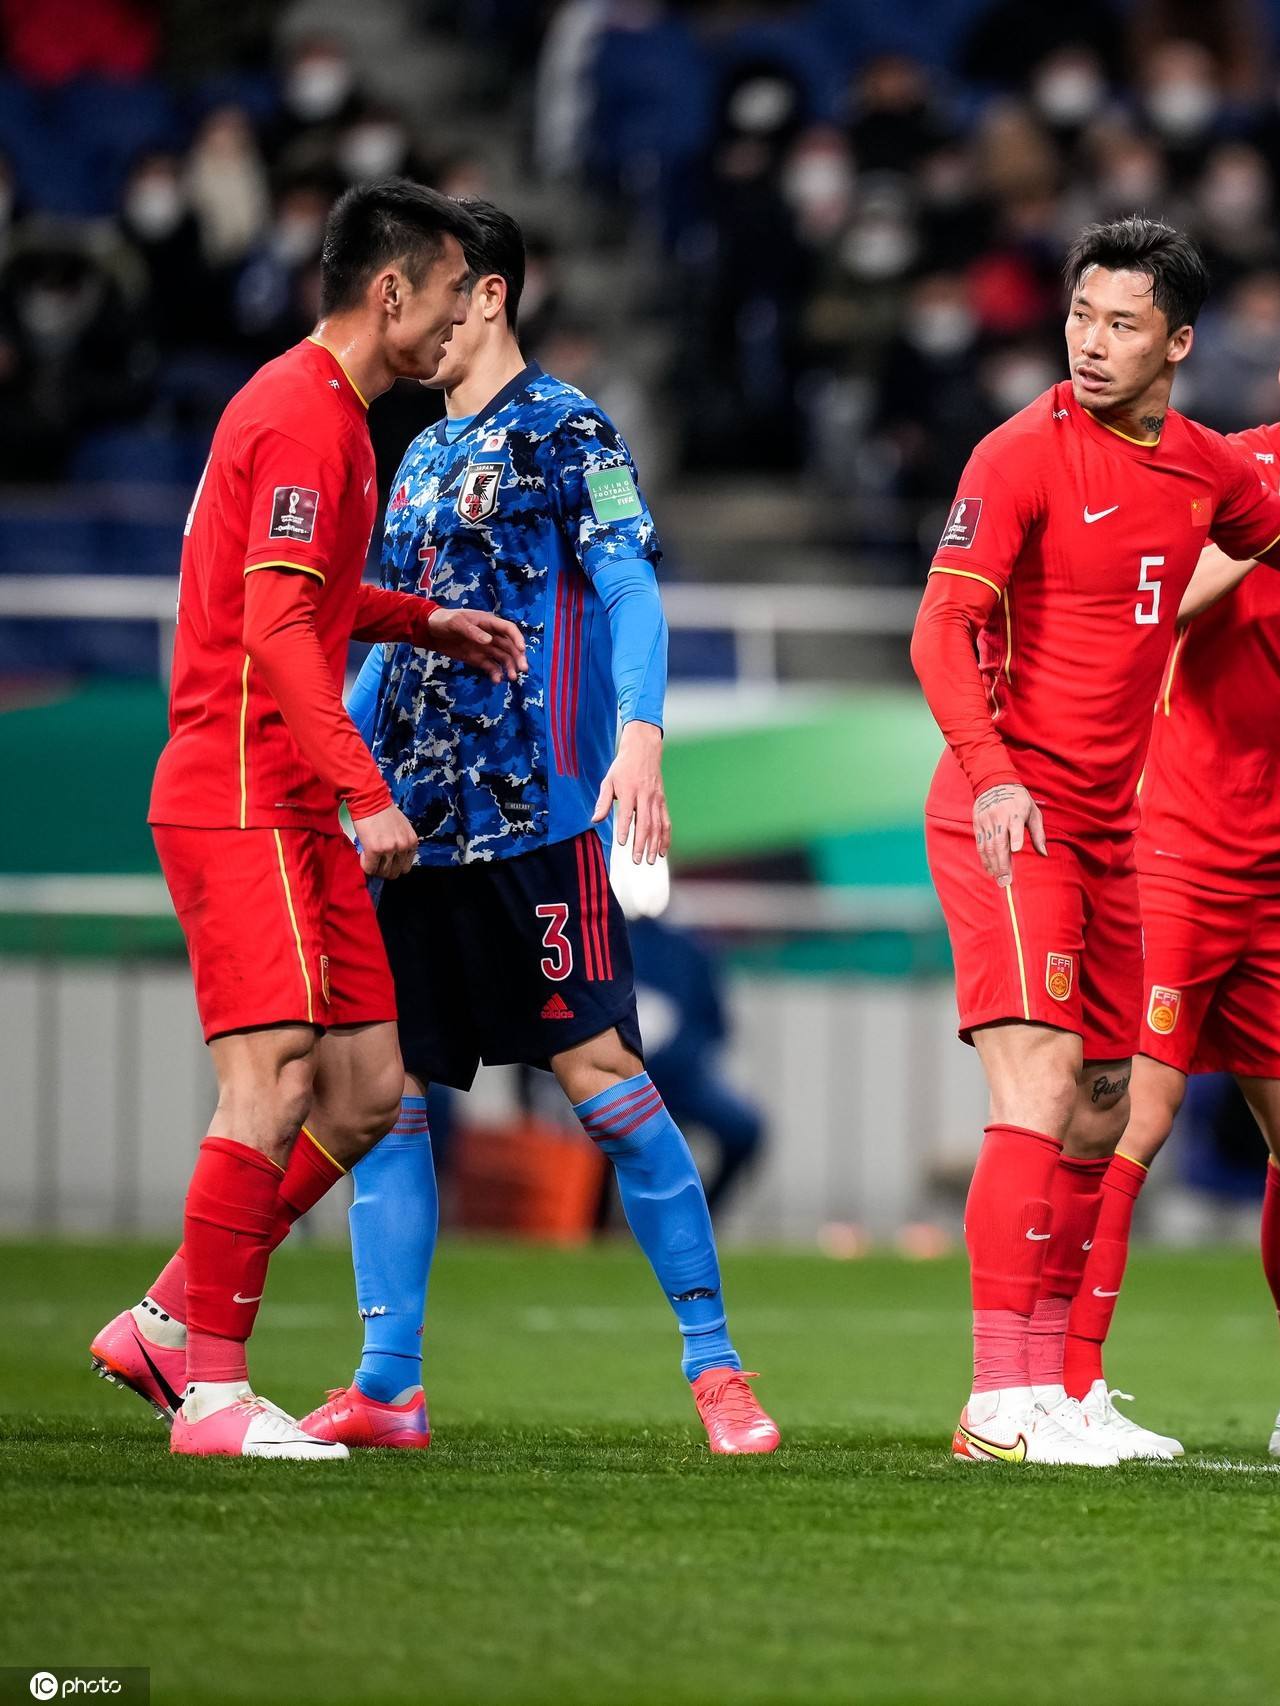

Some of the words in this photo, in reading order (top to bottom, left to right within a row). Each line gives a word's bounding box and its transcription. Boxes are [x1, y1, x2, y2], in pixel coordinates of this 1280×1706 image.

[592, 480, 629, 493] LIVING
[593, 486, 631, 498] FOOTBALL
[617, 496, 635, 505] FIFA
[466, 503, 483, 514] JFA
[1135, 556, 1165, 625] 5
[536, 903, 574, 981] 3
[541, 1010, 575, 1019] adidas
